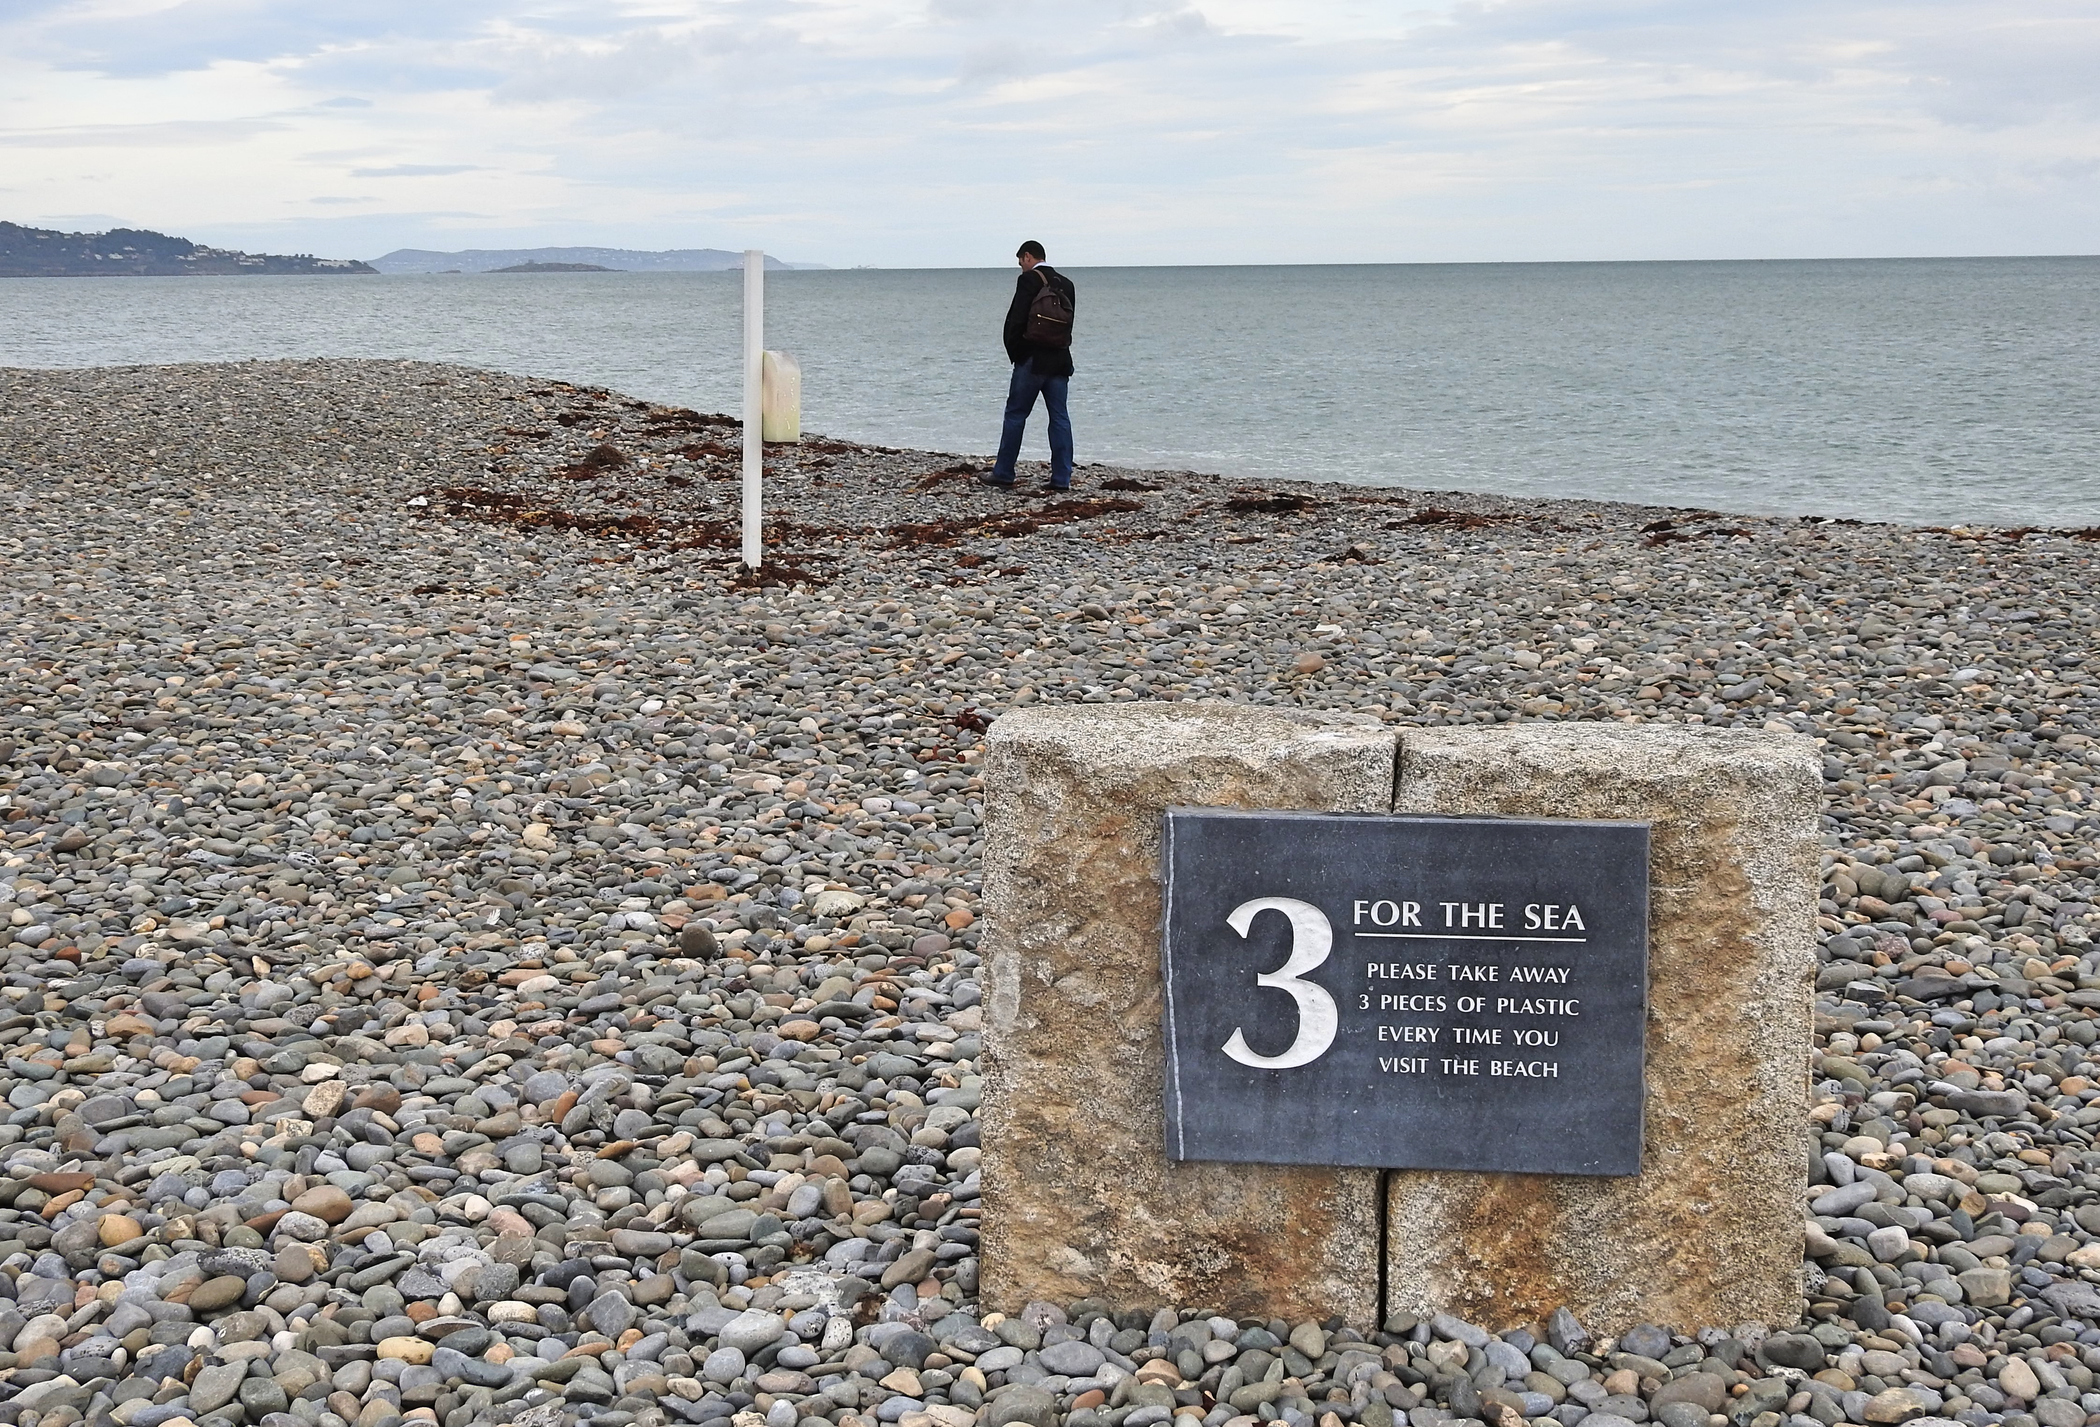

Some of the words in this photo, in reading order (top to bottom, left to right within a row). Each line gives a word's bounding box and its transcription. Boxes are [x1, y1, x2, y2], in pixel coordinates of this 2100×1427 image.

[1353, 899, 1423, 927] FOR
[1439, 901, 1504, 929] THE
[1524, 903, 1586, 931] SEA
[1220, 896, 1339, 1070] 3
[1367, 962, 1437, 980] PLEASE
[1447, 964, 1499, 982] TAKE
[1509, 966, 1571, 984] AWAY
[1358, 993, 1370, 1010] 3
[1380, 994, 1447, 1012] PIECES
[1457, 996, 1486, 1013] OF
[1497, 997, 1580, 1016] PLASTIC
[1378, 1025, 1440, 1043] EVERY
[1452, 1027, 1502, 1045] TIME
[1512, 1029, 1559, 1047] YOU
[1378, 1056, 1430, 1074] VISIT
[1440, 1058, 1480, 1076] THE
[1490, 1060, 1558, 1078] BEACH
